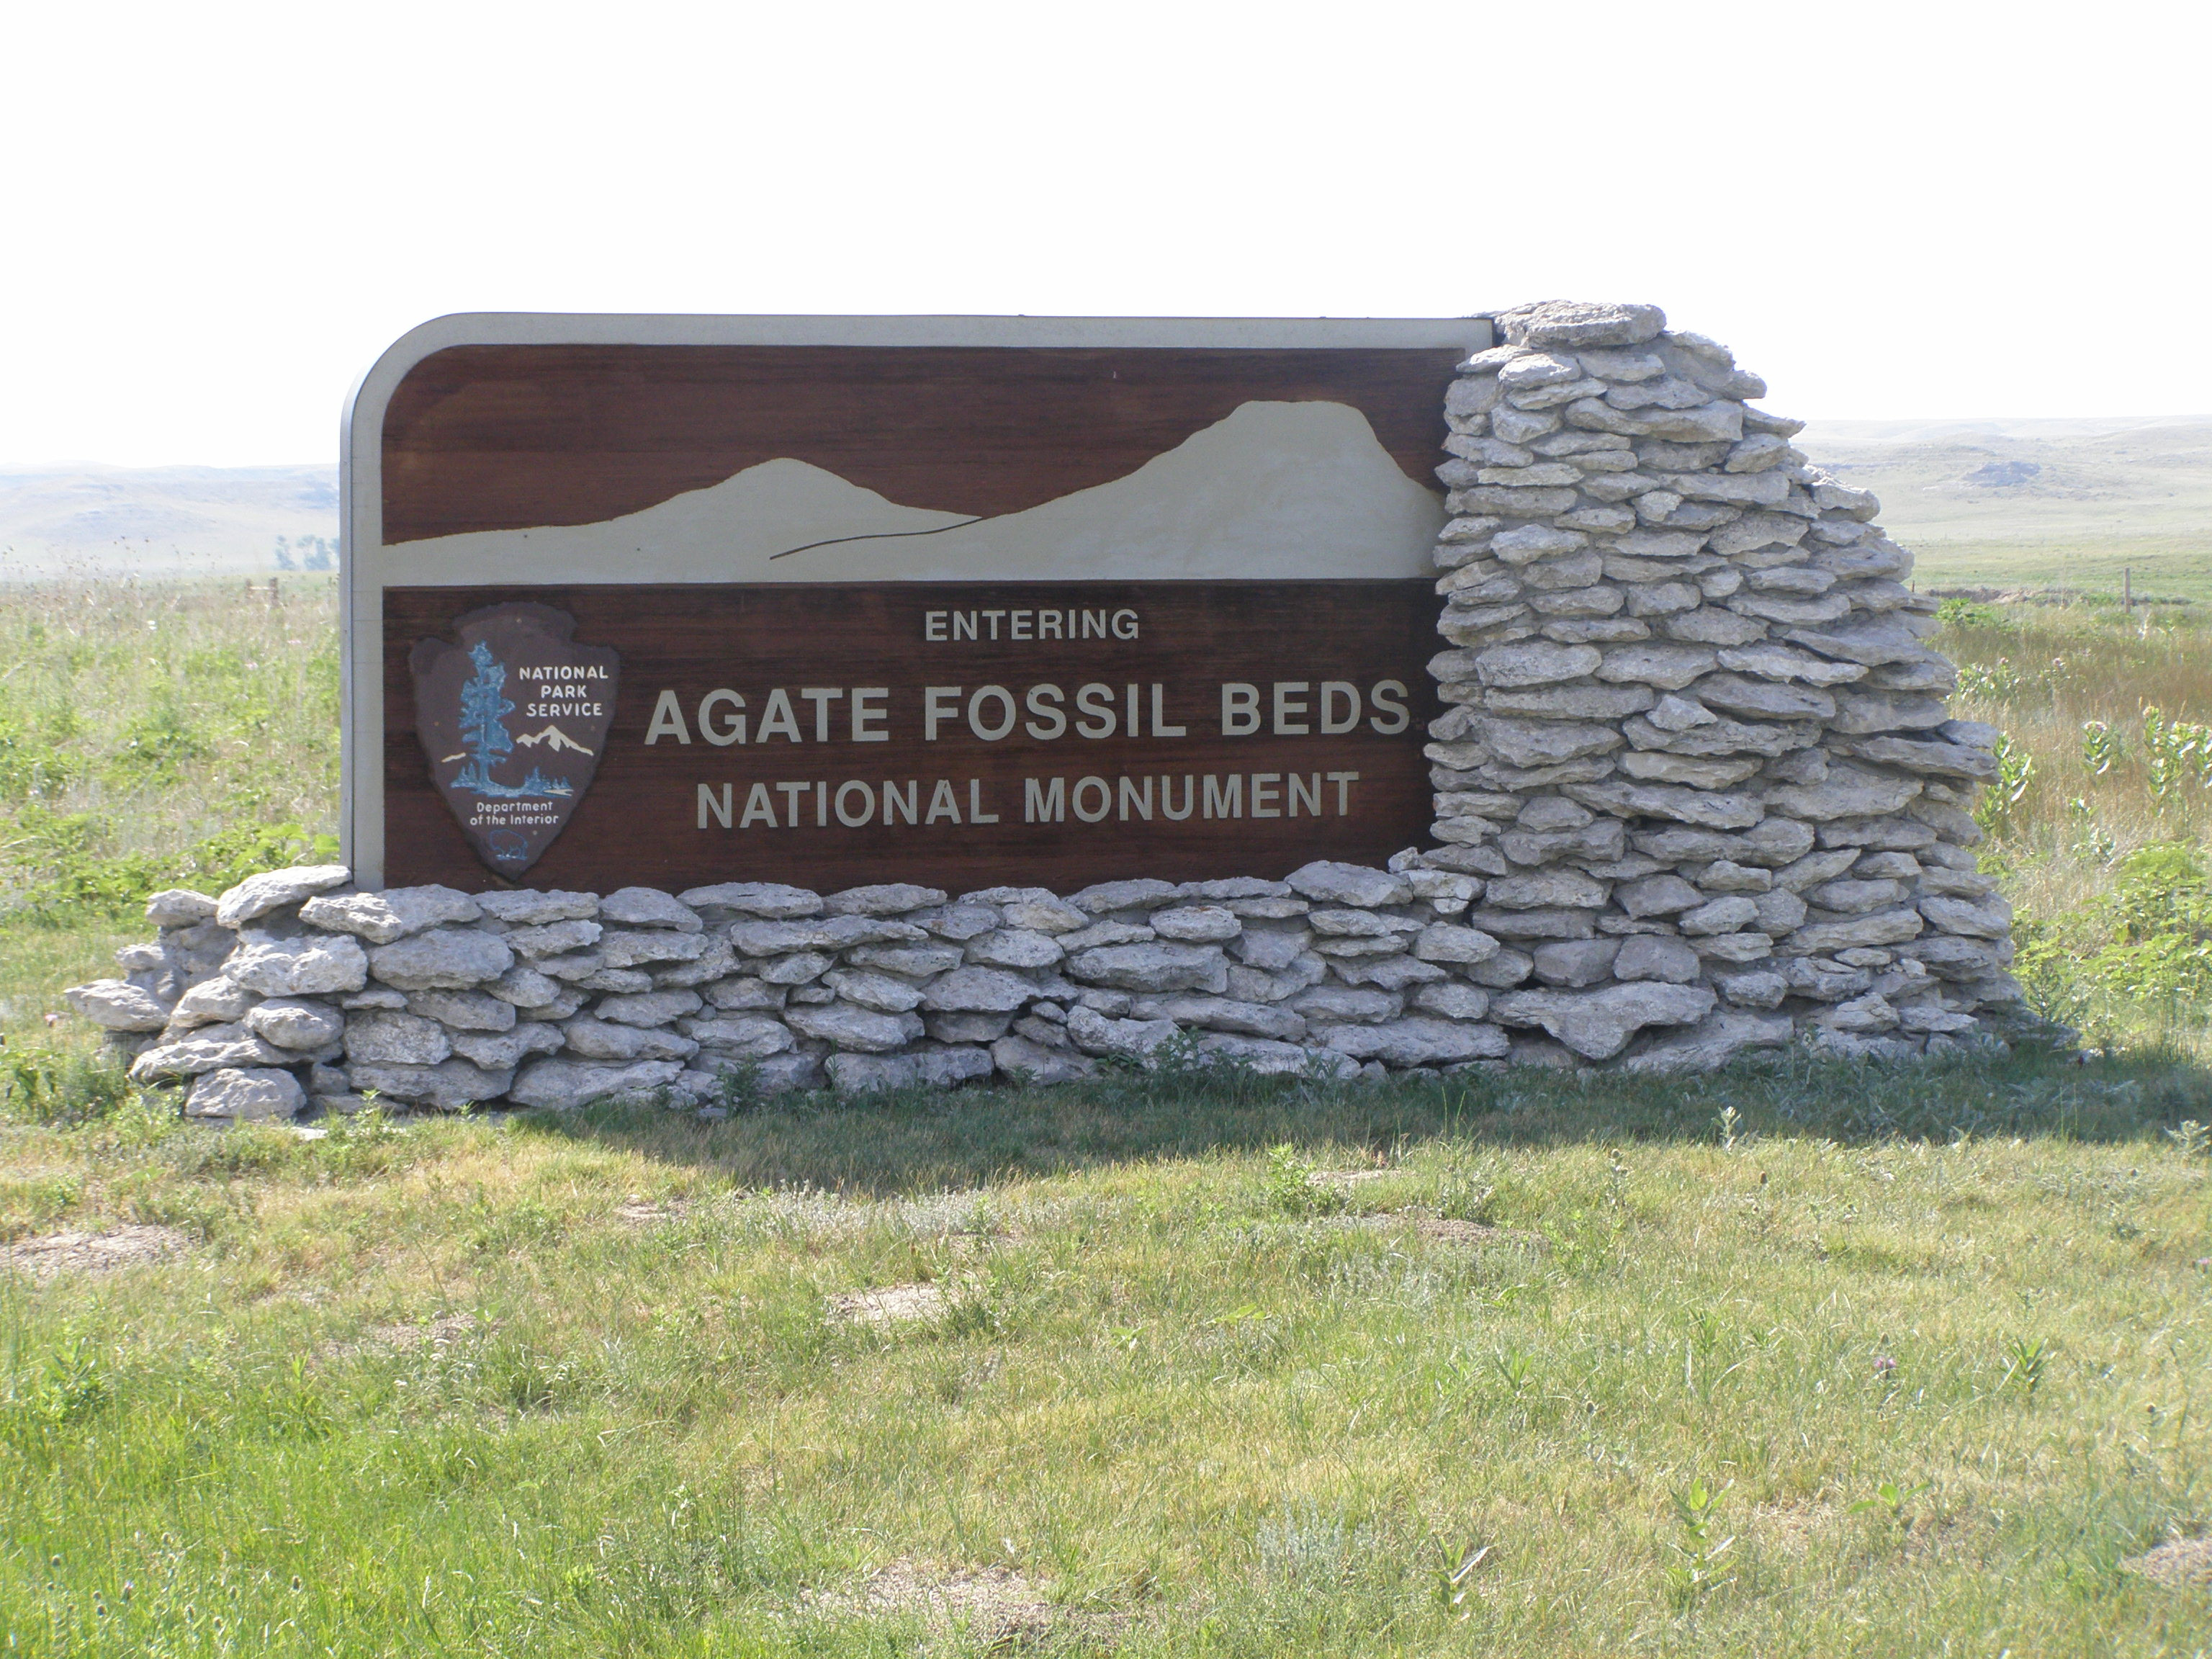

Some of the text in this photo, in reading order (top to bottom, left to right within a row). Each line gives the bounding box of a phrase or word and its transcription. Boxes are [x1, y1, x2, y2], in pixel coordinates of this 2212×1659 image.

[926, 609, 1138, 640] ENTERING
[519, 665, 608, 680] NATIONAL
[541, 685, 587, 698] PARK
[526, 703, 603, 717] SERVICE
[644, 680, 1409, 746] AGATE FOSSIL BEDS
[698, 772, 1359, 828] NATIONAL MONUMENT
[477, 801, 553, 814] Department
[470, 814, 559, 825] of the Interior
